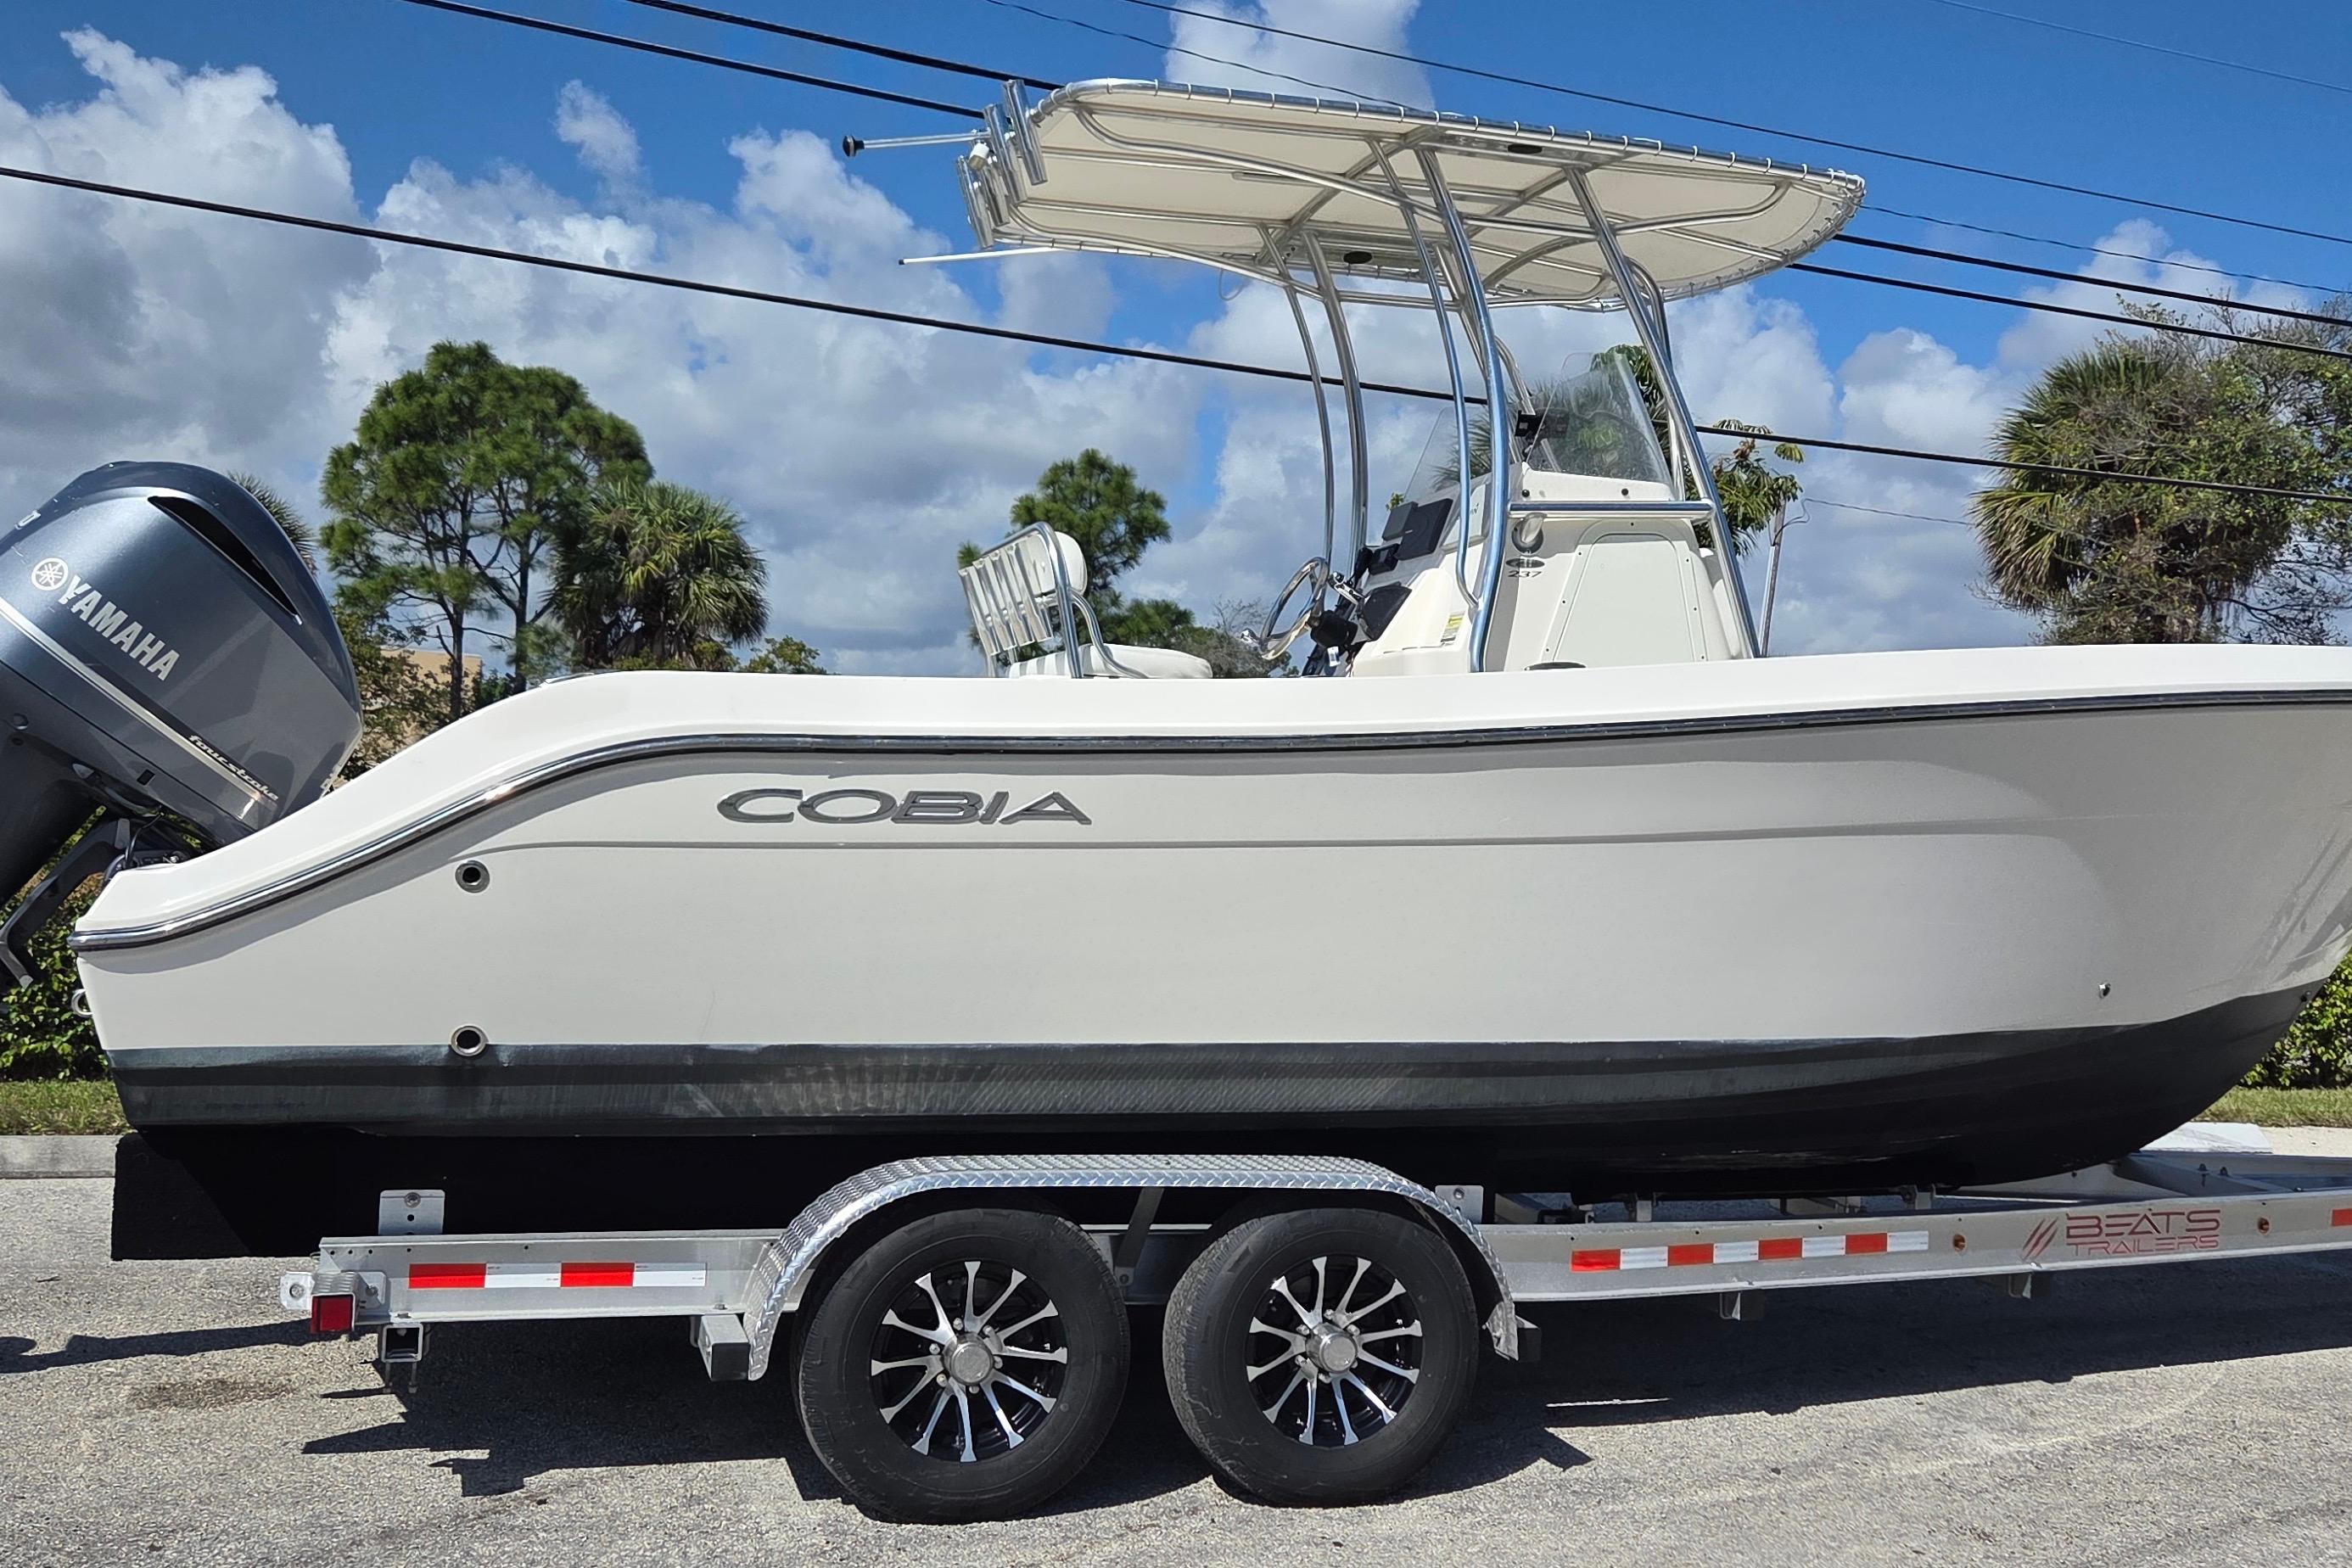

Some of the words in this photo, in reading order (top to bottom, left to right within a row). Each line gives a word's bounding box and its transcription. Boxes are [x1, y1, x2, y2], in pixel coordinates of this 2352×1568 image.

[58, 574, 180, 681] YAMAHA
[717, 787, 1092, 825] COBIA
[2065, 1209, 2221, 1239] BEATS
[2065, 1234, 2220, 1257] TRAILERS
